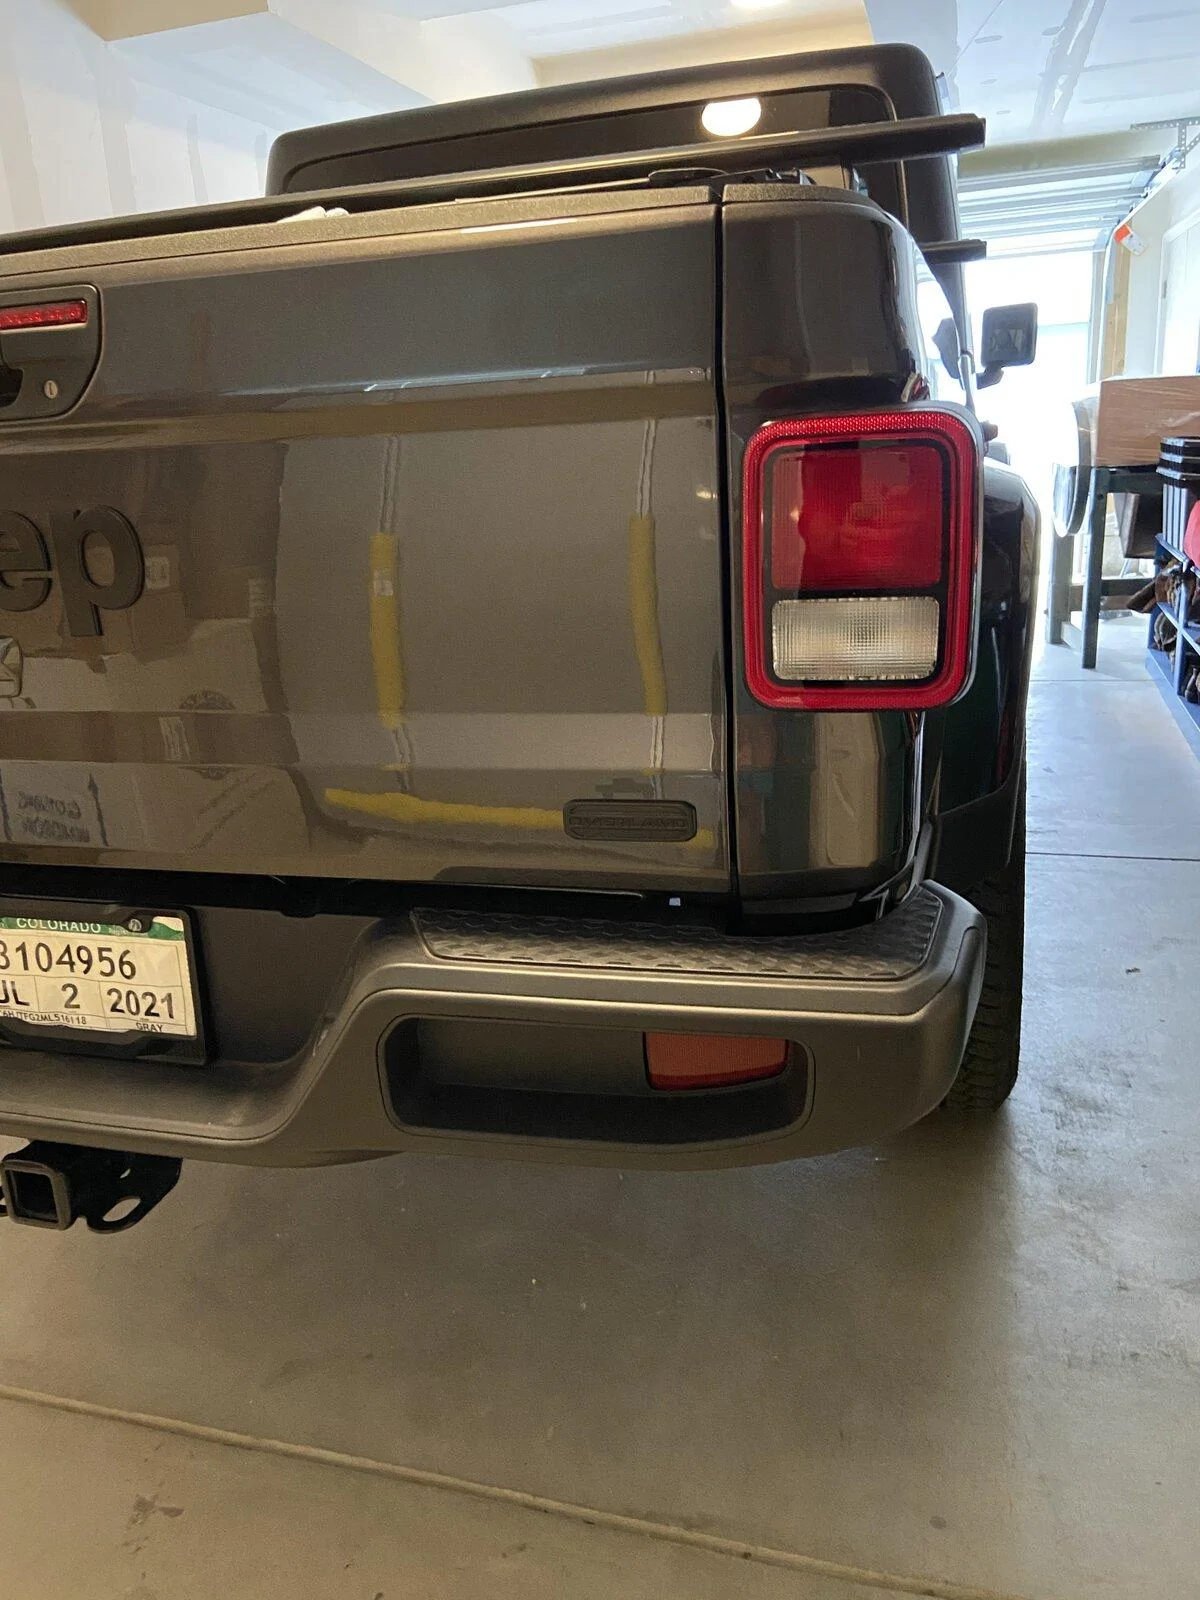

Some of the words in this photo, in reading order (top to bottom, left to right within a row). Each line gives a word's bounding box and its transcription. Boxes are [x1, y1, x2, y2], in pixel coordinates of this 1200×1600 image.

[16, 917, 101, 934] COLORADO
[61, 983, 81, 1009] 2
[106, 987, 174, 1019] 2021
[136, 1022, 164, 1033] GRAY
